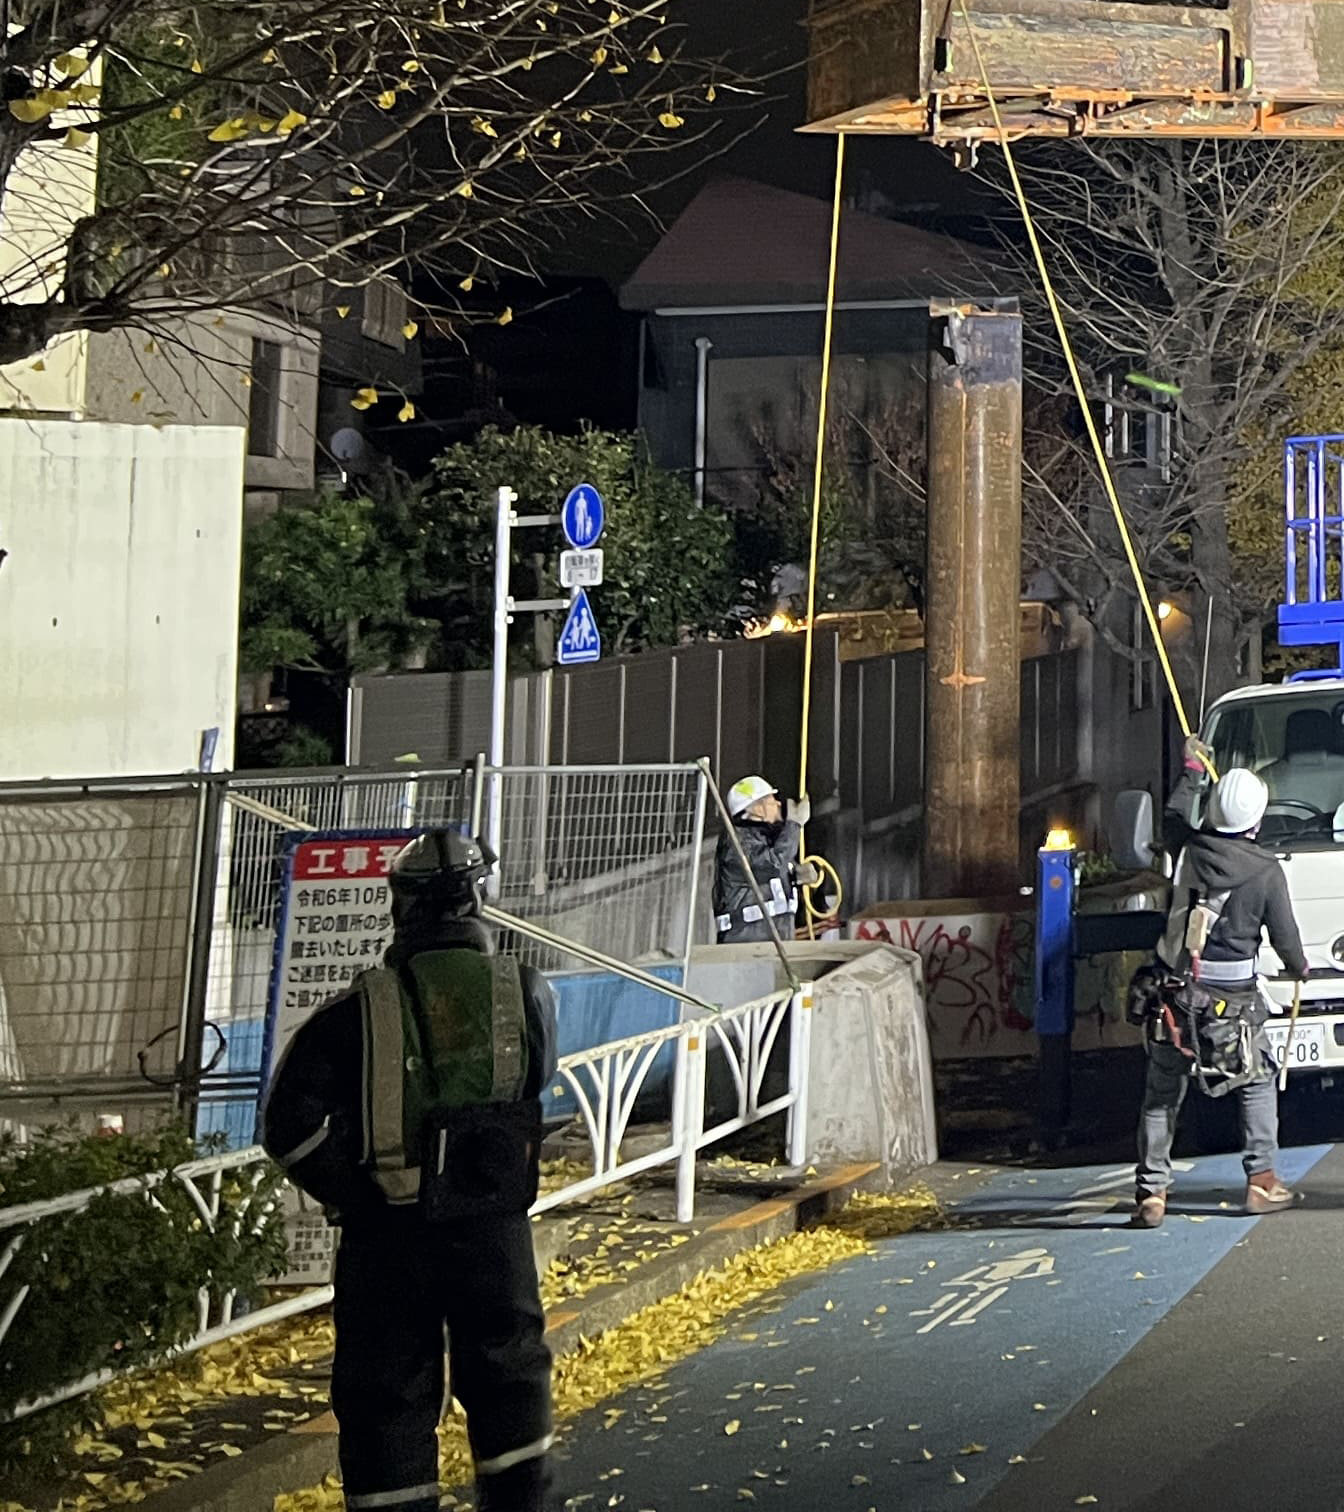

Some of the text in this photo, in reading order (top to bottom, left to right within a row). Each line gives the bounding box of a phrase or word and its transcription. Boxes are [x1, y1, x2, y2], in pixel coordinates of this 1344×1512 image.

[297, 887, 388, 908] 令和6年10月
[1276, 1041, 1320, 1064] 0-08
